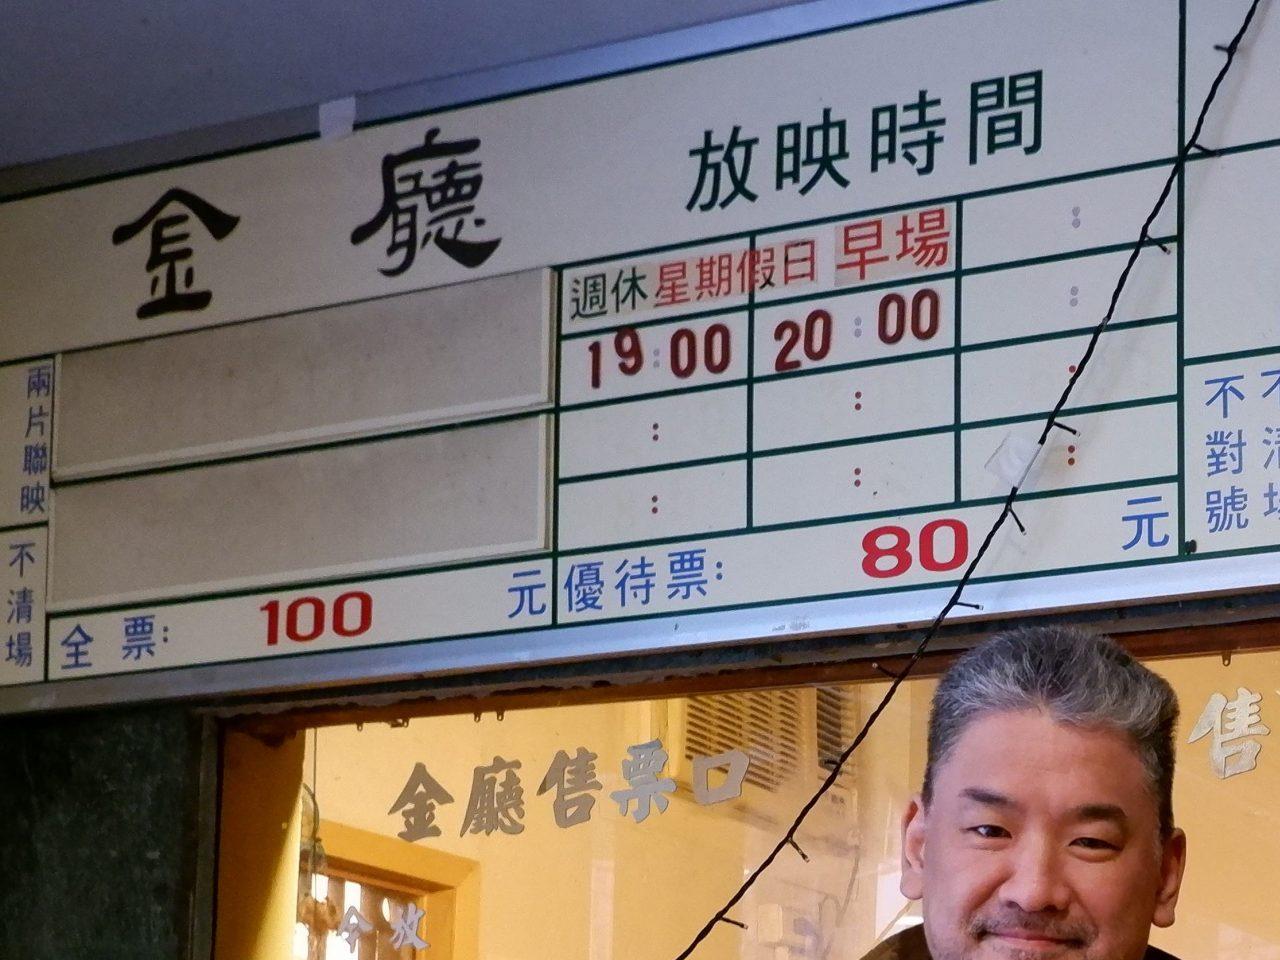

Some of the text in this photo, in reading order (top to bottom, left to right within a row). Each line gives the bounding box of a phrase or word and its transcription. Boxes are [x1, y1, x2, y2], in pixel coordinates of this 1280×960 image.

[686, 69, 1044, 213] 放映時間
[112, 128, 502, 319] 金廳
[836, 207, 951, 281] 早場
[20, 365, 51, 513] 兩片聯映
[1205, 375, 1249, 533] 不對號
[862, 518, 970, 579] 80
[1120, 495, 1171, 552] 元
[5, 542, 36, 668] 不清場
[259, 590, 374, 647] 100
[507, 569, 548, 620] 元
[388, 738, 751, 842] 金廳售票口
